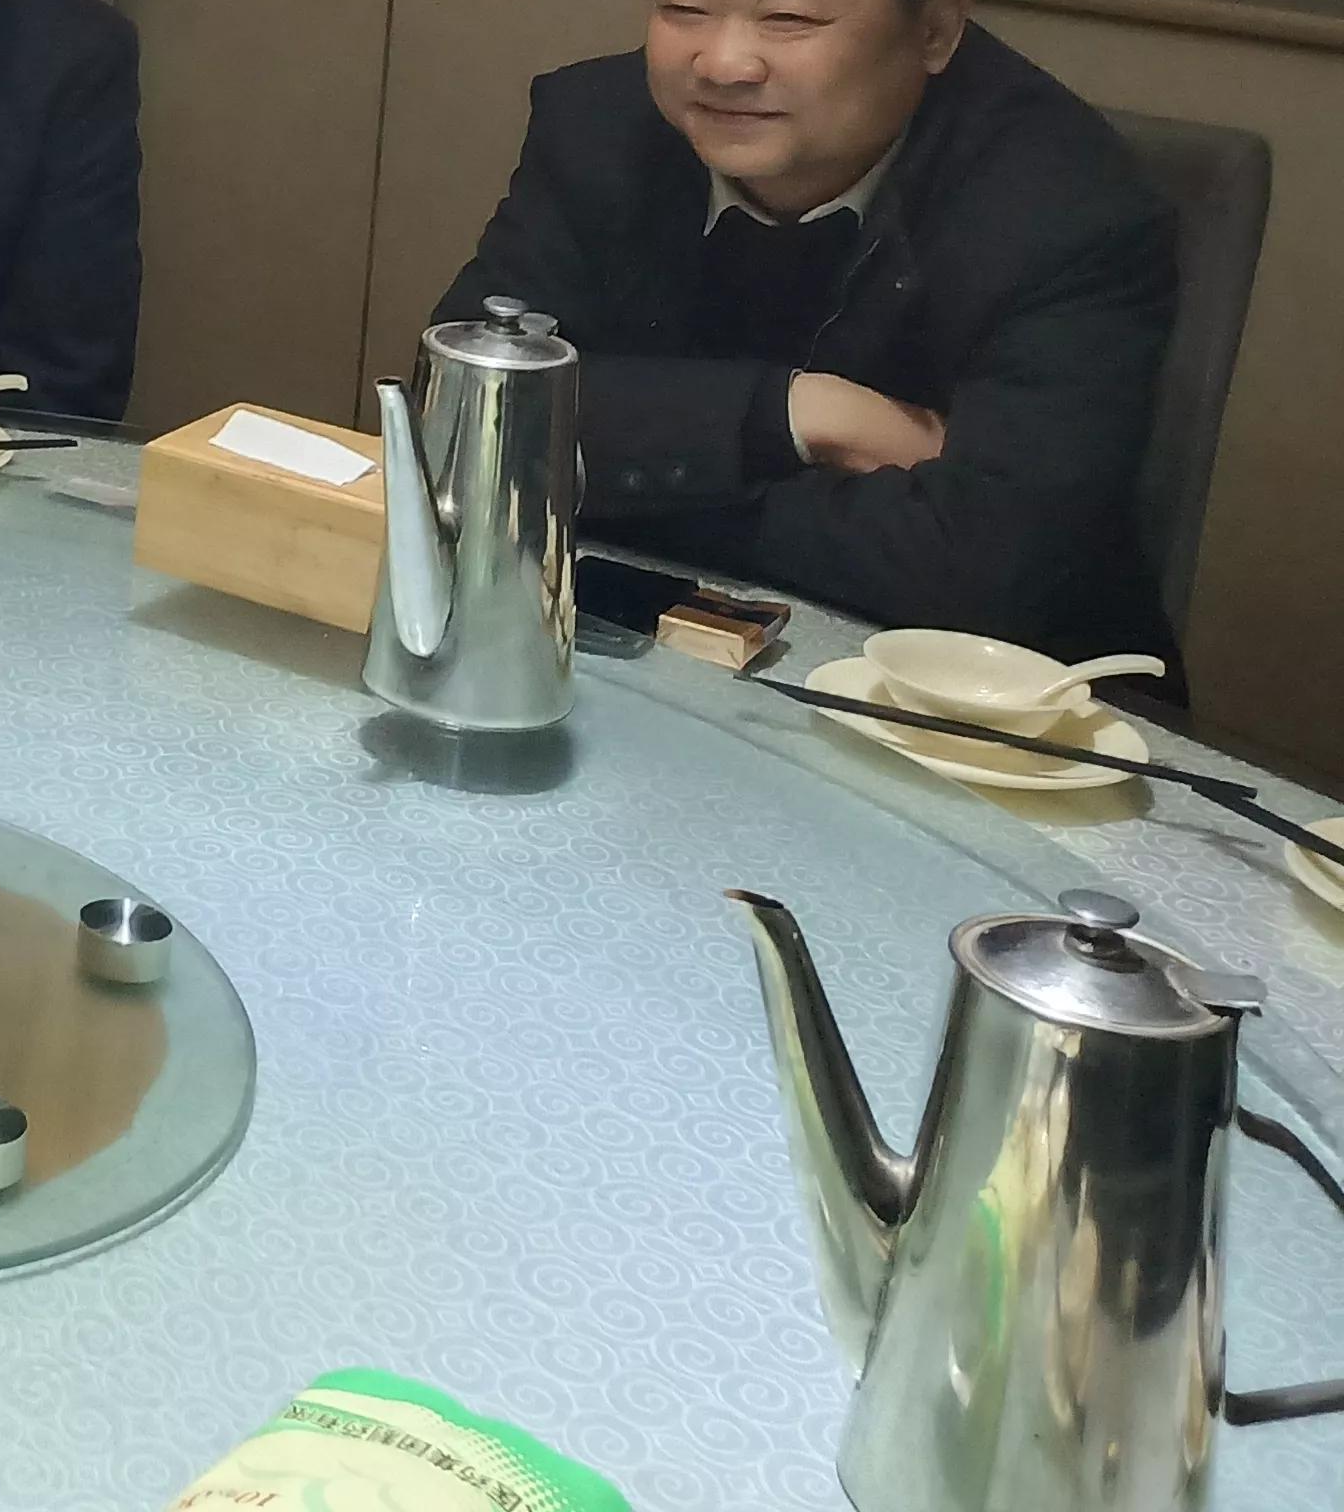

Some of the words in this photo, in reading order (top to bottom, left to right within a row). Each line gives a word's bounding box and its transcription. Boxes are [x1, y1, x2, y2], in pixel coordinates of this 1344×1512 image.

[283, 1403, 533, 1512] 医药集团制药有限
